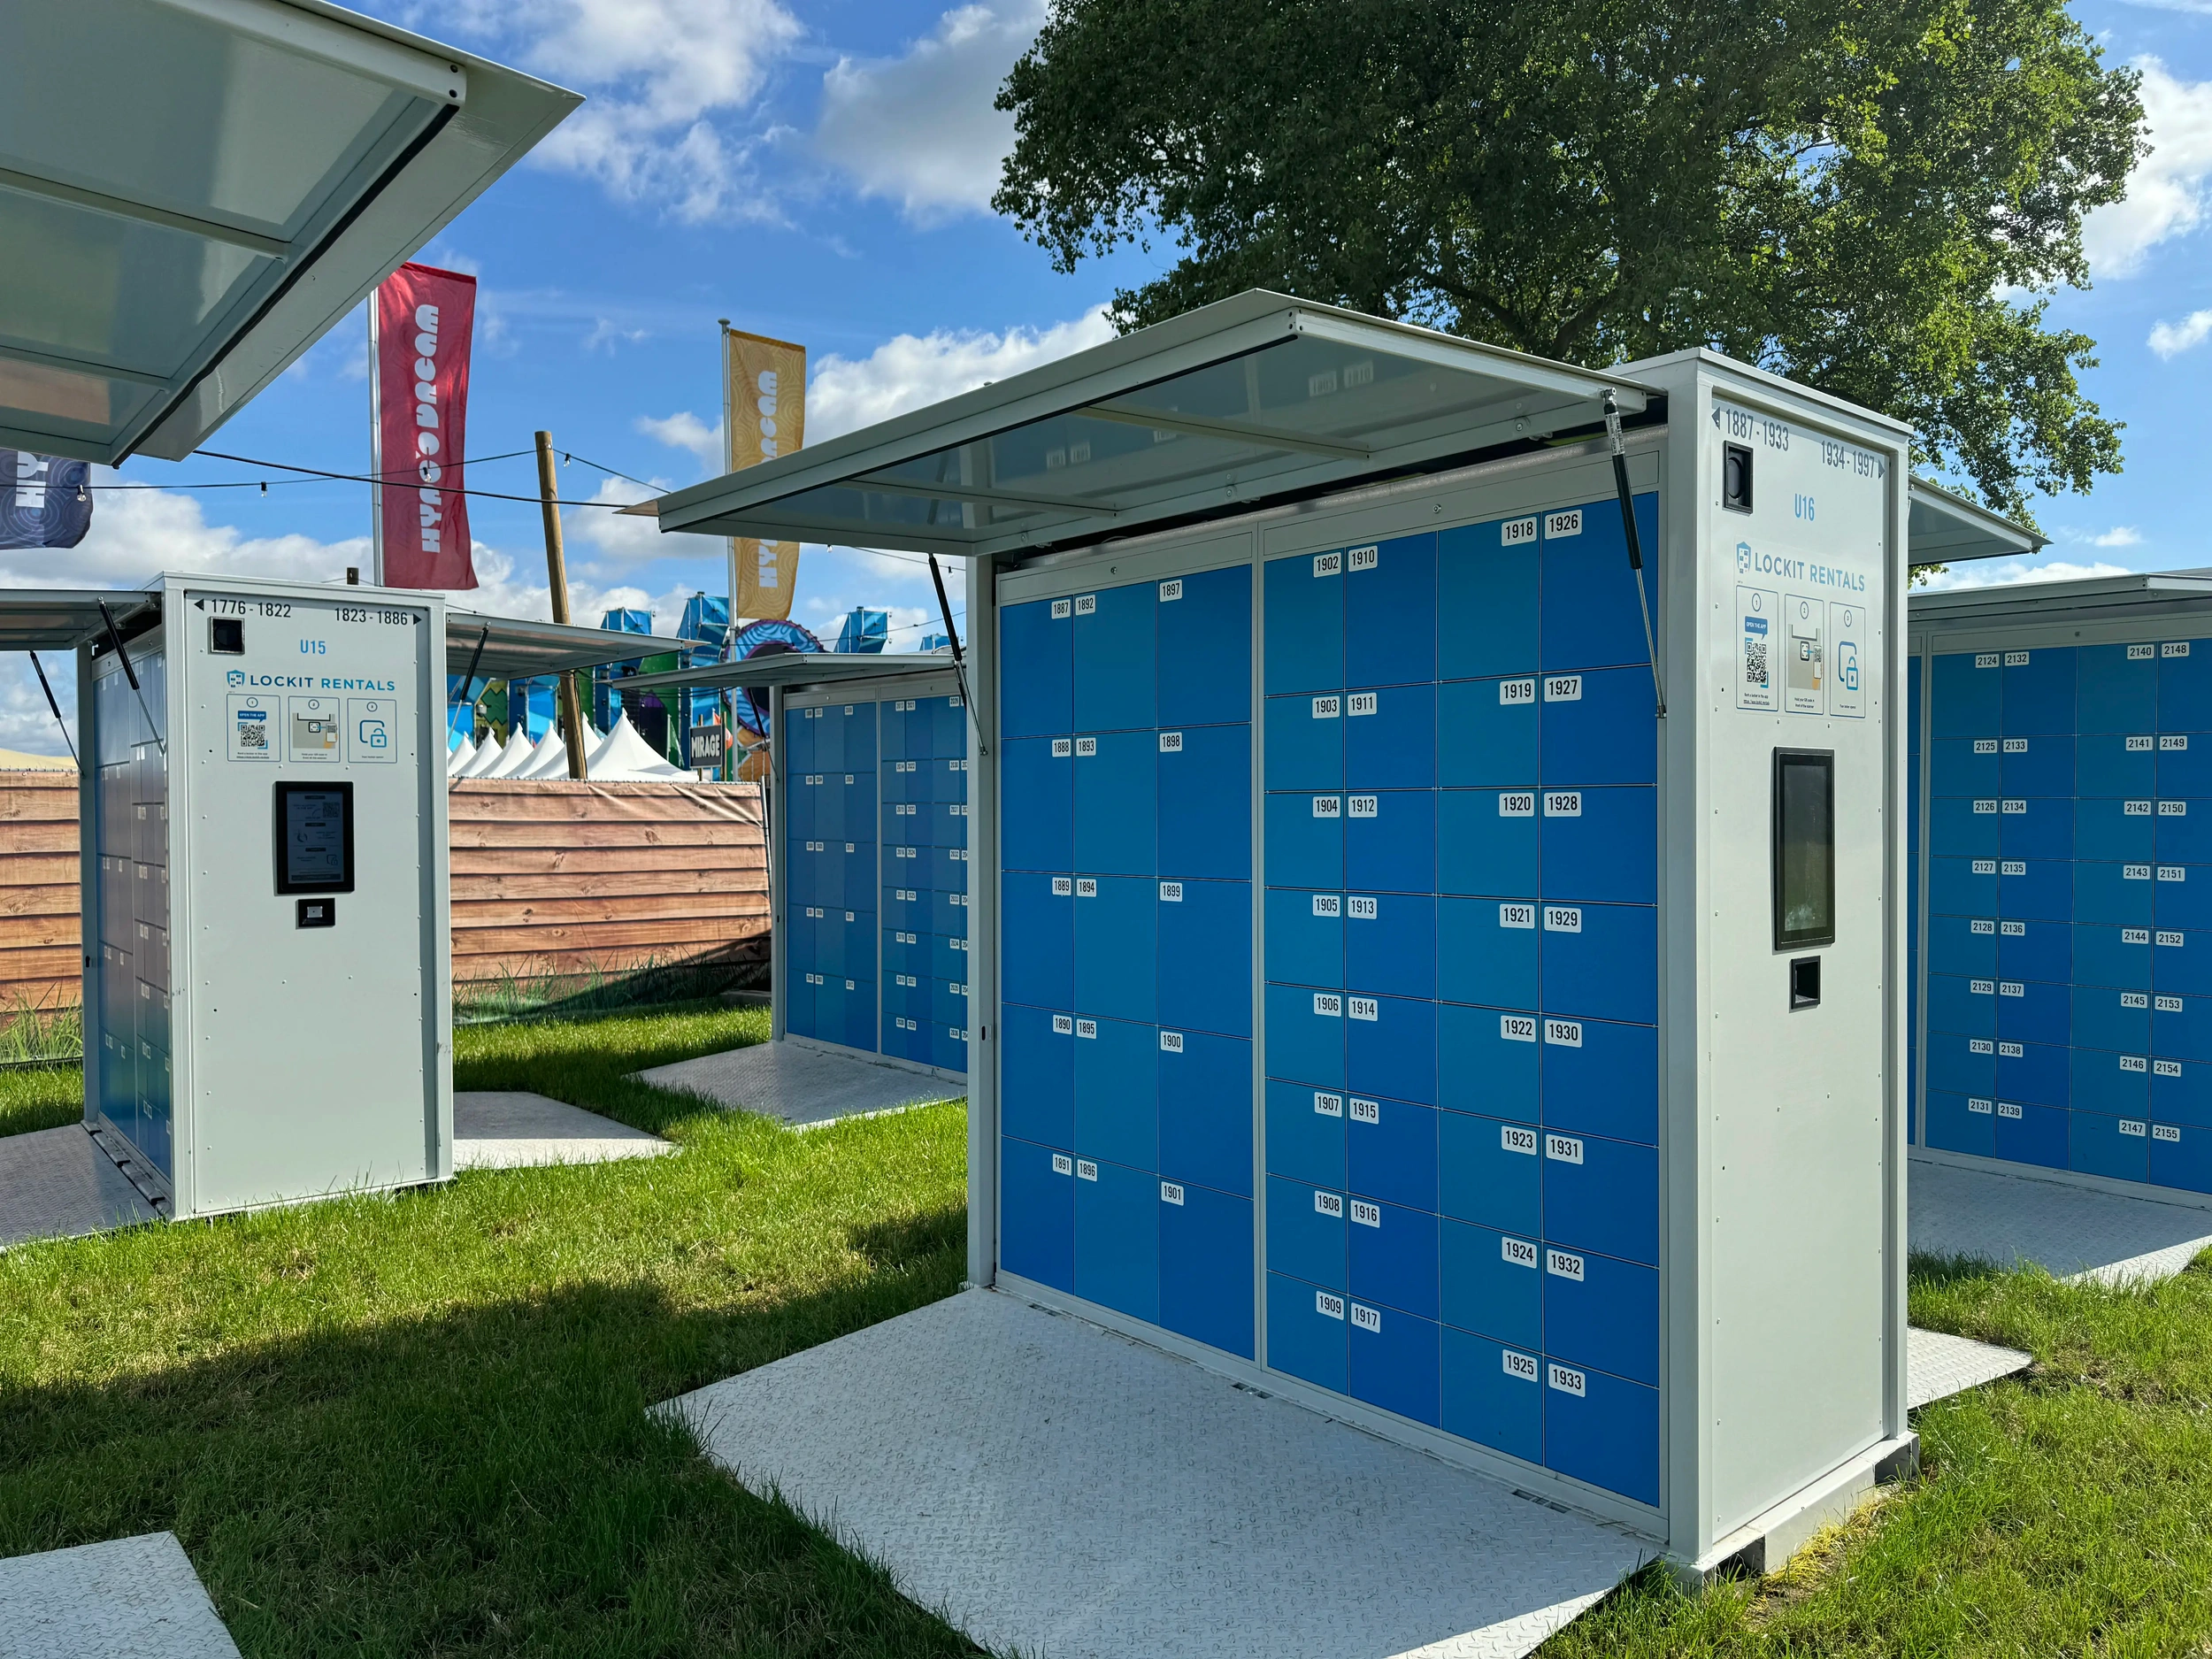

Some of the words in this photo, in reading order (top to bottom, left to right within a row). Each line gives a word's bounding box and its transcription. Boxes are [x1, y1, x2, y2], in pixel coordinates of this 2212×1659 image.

[1725, 408, 1754, 441] 1887
[1763, 420, 1789, 452] 1933
[1821, 440, 1845, 470] 1934
[1852, 449, 1875, 479] 1997
[1794, 493, 1815, 521] U16
[1550, 514, 1578, 532] 1926
[1506, 521, 1532, 539] 1918
[1352, 549, 1374, 565] 1910
[1317, 556, 1338, 572] 1902
[1755, 552, 1805, 580] LOCKIT
[1809, 564, 1865, 592] RENTALS
[1163, 583, 1179, 596] 1897
[211, 598, 247, 615] 1776
[257, 602, 292, 618] 1822
[1055, 603, 1068, 614] 1887
[1079, 598, 1093, 611] 1892
[334, 607, 366, 623] 1823
[377, 611, 408, 626] 1886
[300, 639, 326, 655] U15
[2131, 648, 2151, 657] 2140
[2164, 645, 2186, 654] 2148
[1978, 657, 1997, 665] 2124
[2007, 654, 2027, 664] 2132
[250, 674, 314, 688] LOCKIT
[320, 678, 396, 691] RENTALS
[1549, 680, 1577, 695] 1927
[1504, 683, 1531, 698] 1919
[1317, 699, 1337, 713] 1903
[1352, 696, 1372, 710] 1911
[691, 734, 720, 758] MIRAGE
[1055, 741, 1069, 752] 1888
[1079, 741, 1094, 751] 1893
[1163, 735, 1179, 747] 1898
[1317, 800, 1338, 812] 1904
[1352, 799, 1374, 812] 1912
[1504, 796, 1530, 810] 1920
[1548, 796, 1577, 810] 1928
[2127, 803, 2148, 812] 2142
[2004, 864, 2023, 872] 2135
[1055, 880, 1069, 891] 1889
[1079, 881, 1094, 892] 1894
[1163, 885, 1180, 897] 1899
[1317, 899, 1337, 911] 1905
[1352, 900, 1373, 913] 1913
[1504, 908, 1529, 922] 1921
[1549, 911, 1577, 926] 1929
[2003, 924, 2023, 933] 2136
[2125, 932, 2146, 941] 2144
[2159, 934, 2180, 943] 2152
[1973, 982, 1991, 991] 2129
[2002, 985, 2021, 994] 2137
[1317, 997, 1338, 1010] 1906
[2124, 995, 2145, 1005] 2145
[2158, 999, 2179, 1009] 2153
[1352, 1001, 1375, 1015] 1914
[1056, 1018, 1070, 1030] 1890
[1079, 1023, 1094, 1034] 1895
[1505, 1019, 1532, 1035] 1922
[1549, 1024, 1578, 1041] 1930
[1164, 1035, 1180, 1048] 1900
[1972, 1042, 1991, 1051] 2130
[2001, 1045, 2020, 1055] 2138
[2123, 1059, 2143, 1069] 2146
[2156, 1064, 2178, 1073] 2154
[1318, 1096, 1339, 1111] 1907
[1354, 1102, 1375, 1118] 1915
[1971, 1101, 1988, 1110] 2131
[2001, 1106, 2019, 1116] 2139
[2122, 1123, 2142, 1133] 2147
[2155, 1128, 2177, 1138] 2155
[1506, 1131, 1532, 1148] 1923
[1551, 1140, 1577, 1157] 1931
[1056, 1157, 1069, 1171] 1891
[1080, 1164, 1095, 1176] 1896
[1164, 1186, 1180, 1200] 1901
[1318, 1195, 1340, 1211] 1908
[1355, 1204, 1377, 1221] 1916
[1507, 1242, 1533, 1262] 1924
[1552, 1255, 1579, 1274] 1932
[1320, 1295, 1340, 1313] 1909
[1356, 1308, 1377, 1325] 1917
[1508, 1355, 1533, 1375] 1925
[1554, 1369, 1581, 1389] 1933
